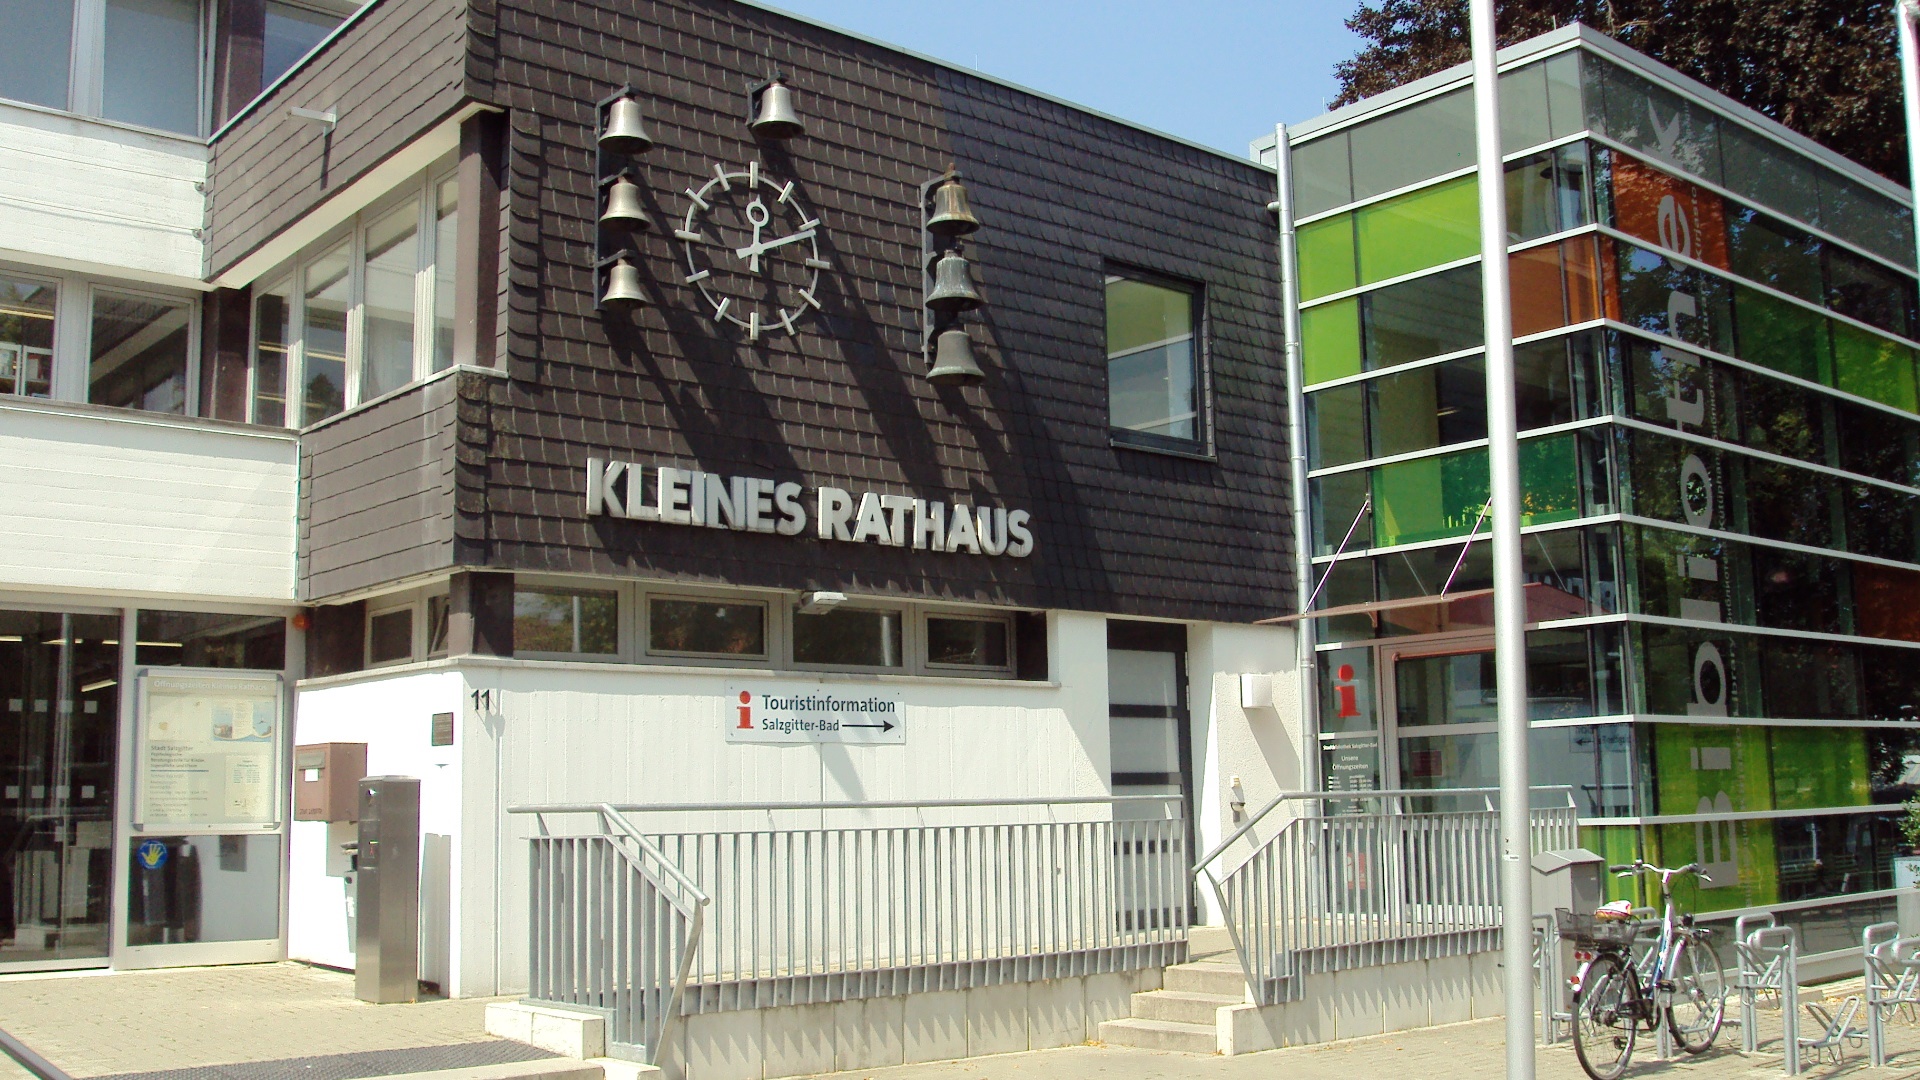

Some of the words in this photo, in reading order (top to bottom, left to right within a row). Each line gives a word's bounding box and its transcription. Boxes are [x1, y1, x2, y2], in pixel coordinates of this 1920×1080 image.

[1643, 97, 1738, 889] Bibliothek
[586, 457, 807, 535] KLEINES
[818, 486, 1034, 557] RATHAUS
[471, 689, 489, 710] 11
[762, 694, 895, 713] Touristinformation
[762, 718, 839, 734] Salzgitter-Bad
[1332, 763, 1369, 771] Öffnungszeiten
